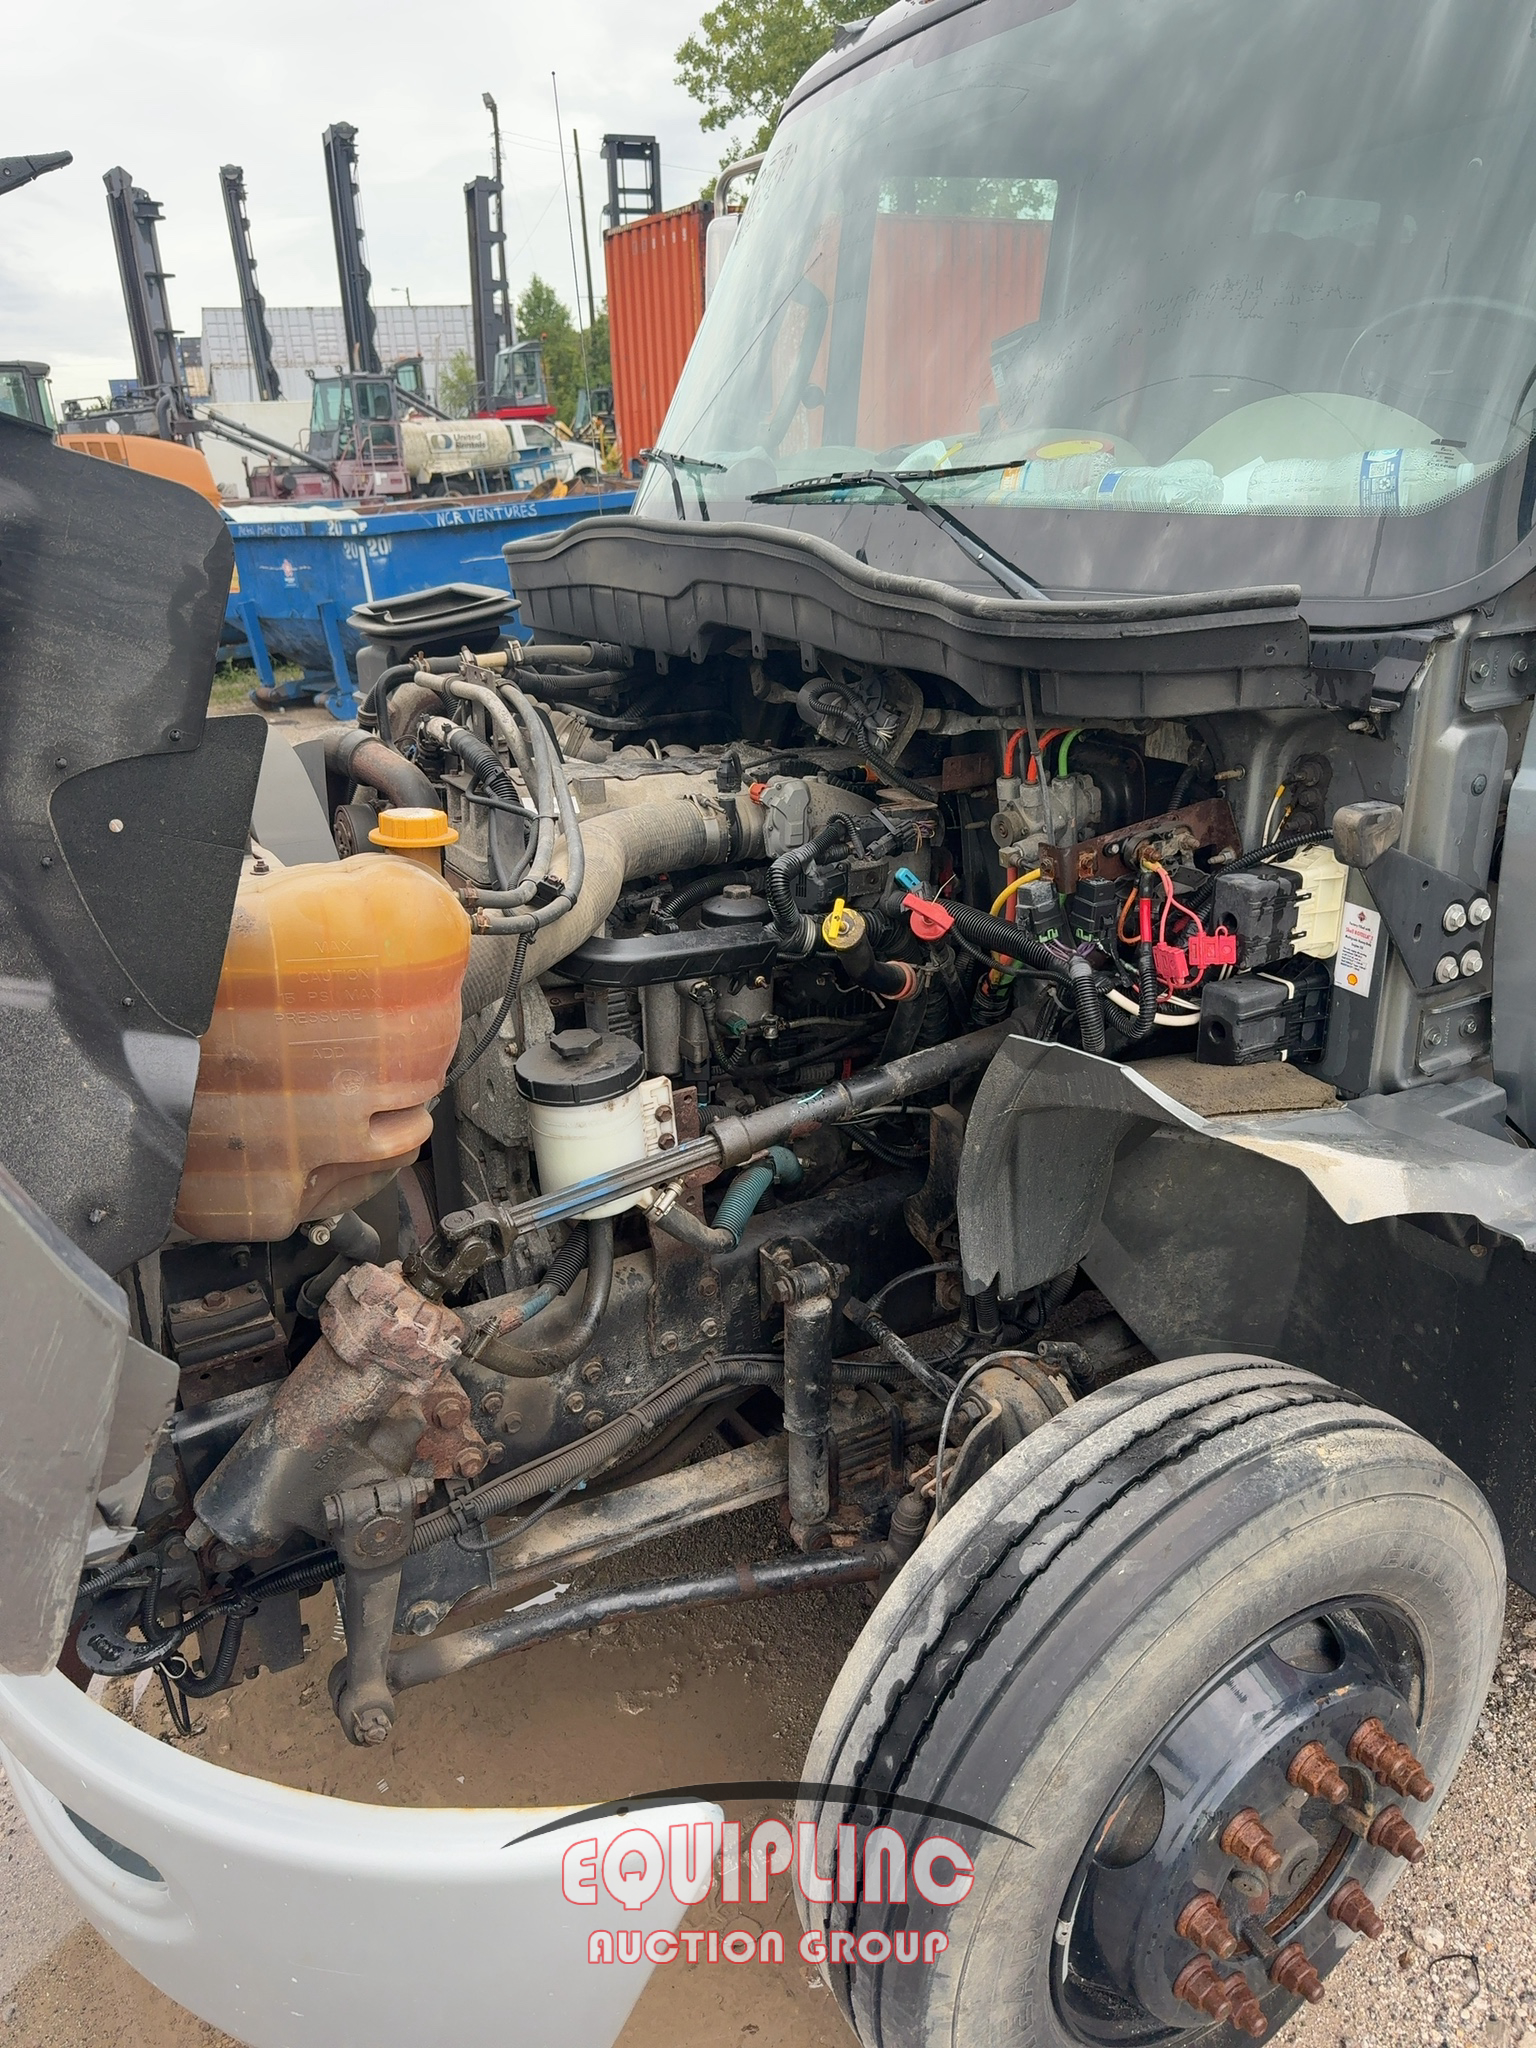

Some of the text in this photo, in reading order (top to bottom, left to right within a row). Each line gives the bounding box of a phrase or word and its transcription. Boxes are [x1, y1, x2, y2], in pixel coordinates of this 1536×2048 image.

[453, 433, 482, 441] United
[455, 441, 486, 449] Rentals
[436, 504, 538, 527] NCR VENTURES
[314, 940, 352, 953] MAX
[297, 968, 369, 983] CAUTION
[307, 991, 334, 1003] PSI
[273, 1008, 363, 1026] PRESSURE
[312, 1046, 345, 1060] ADD
[1000, 1923, 1048, 2048] EAR
